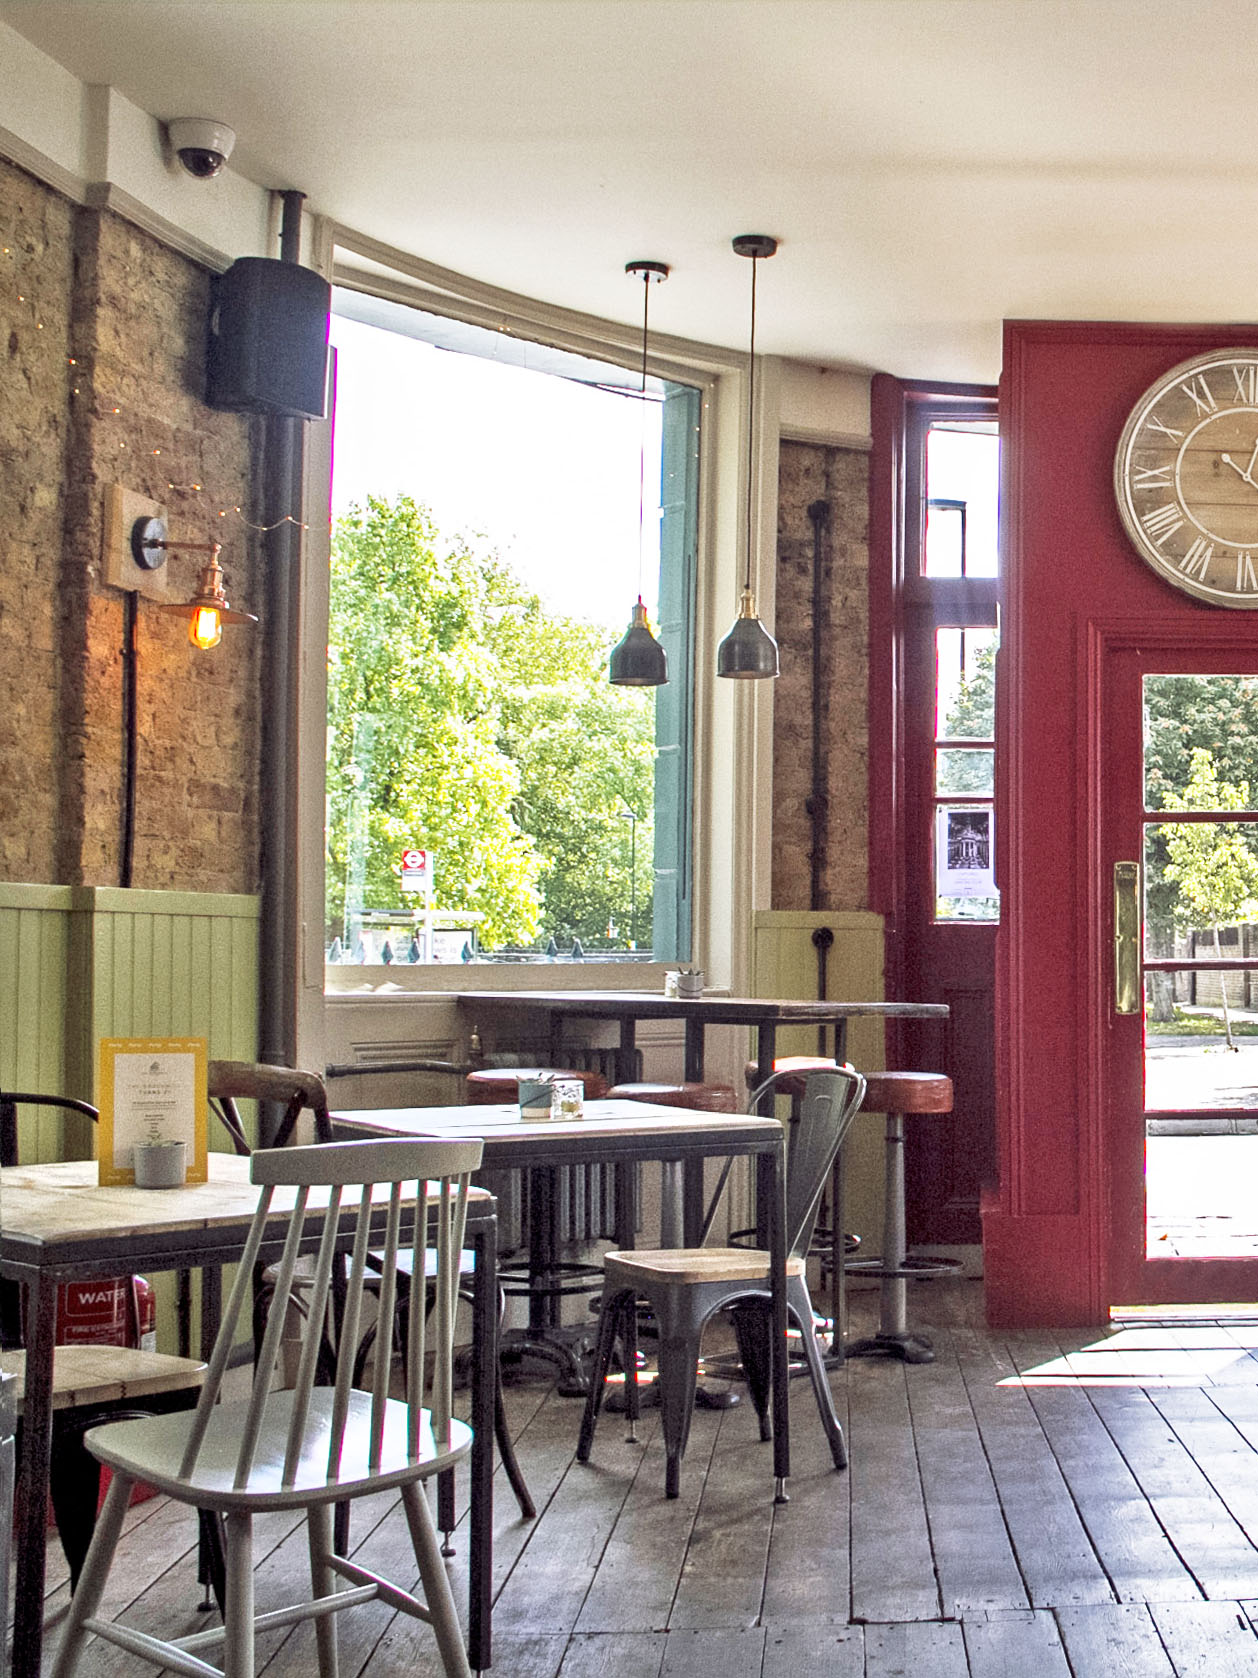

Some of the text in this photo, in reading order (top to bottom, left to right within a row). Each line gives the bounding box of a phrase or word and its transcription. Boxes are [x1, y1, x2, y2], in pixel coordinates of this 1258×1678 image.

[1179, 374, 1218, 418] XI
[1145, 415, 1185, 445] X
[1133, 464, 1174, 491] IX
[1140, 501, 1186, 548] VIII
[1178, 535, 1214, 582] VII
[1236, 551, 1258, 591] VI
[78, 1287, 126, 1305] WATER
